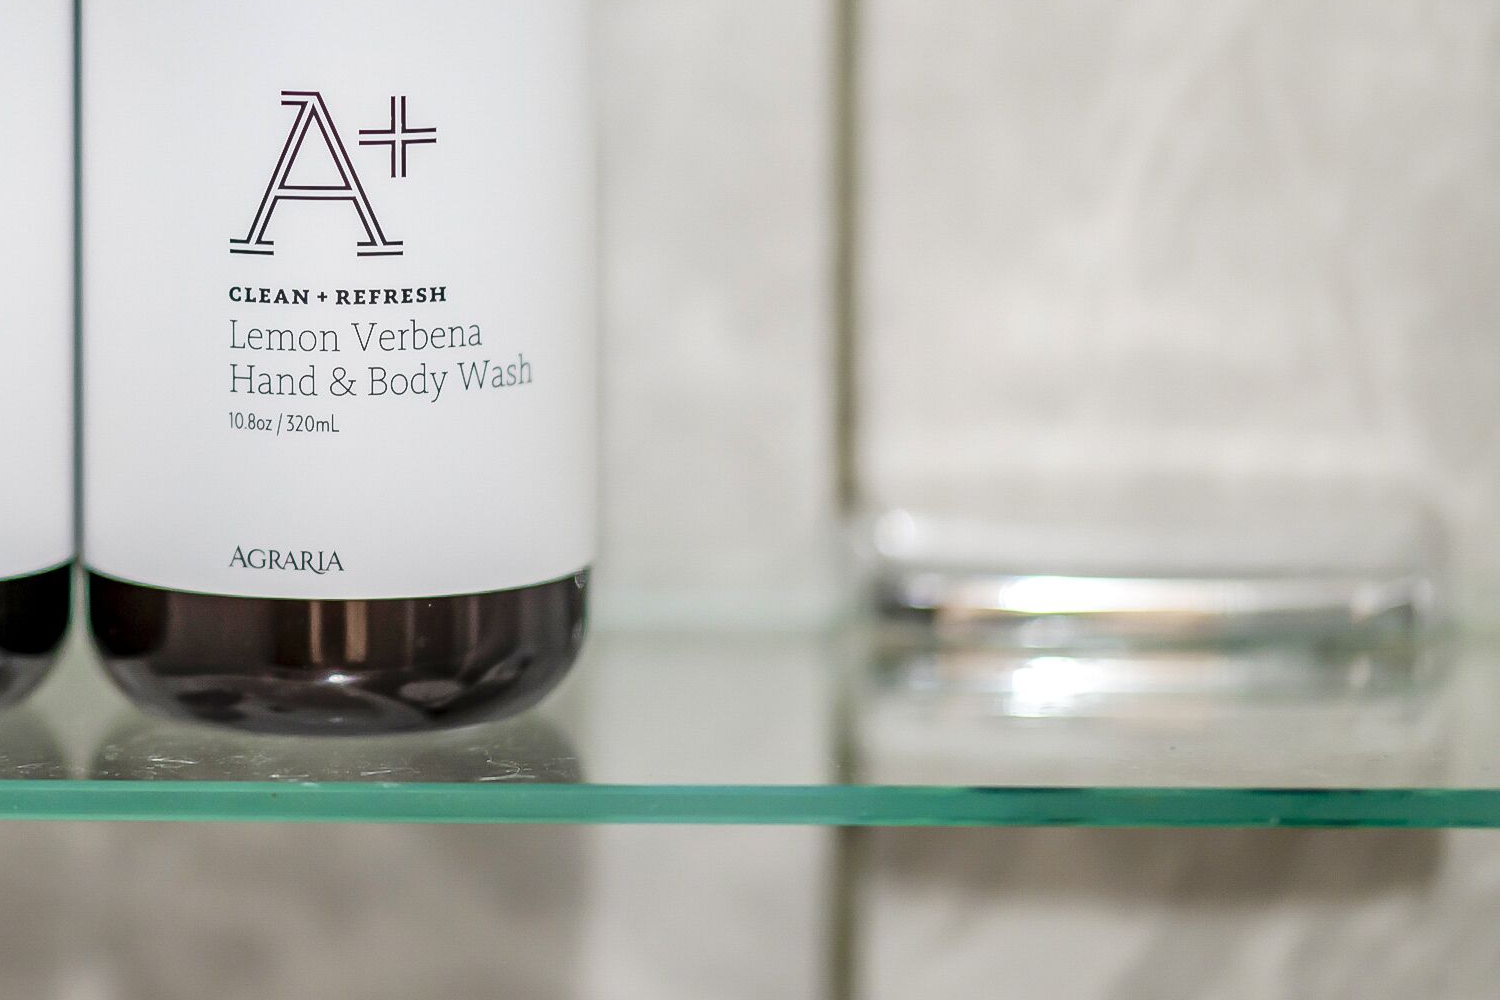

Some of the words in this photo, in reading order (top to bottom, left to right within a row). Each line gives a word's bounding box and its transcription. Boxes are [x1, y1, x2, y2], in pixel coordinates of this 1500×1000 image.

[229, 287, 309, 304] CLEAN
[317, 292, 328, 302] +
[335, 286, 446, 305] REFRESH
[230, 319, 340, 352] Lemon
[351, 319, 482, 351] Verbena
[230, 364, 318, 396] Hand
[330, 367, 357, 396] &
[368, 363, 448, 403] Body
[457, 353, 532, 390] Wash
[229, 545, 344, 575] AGRARIA
